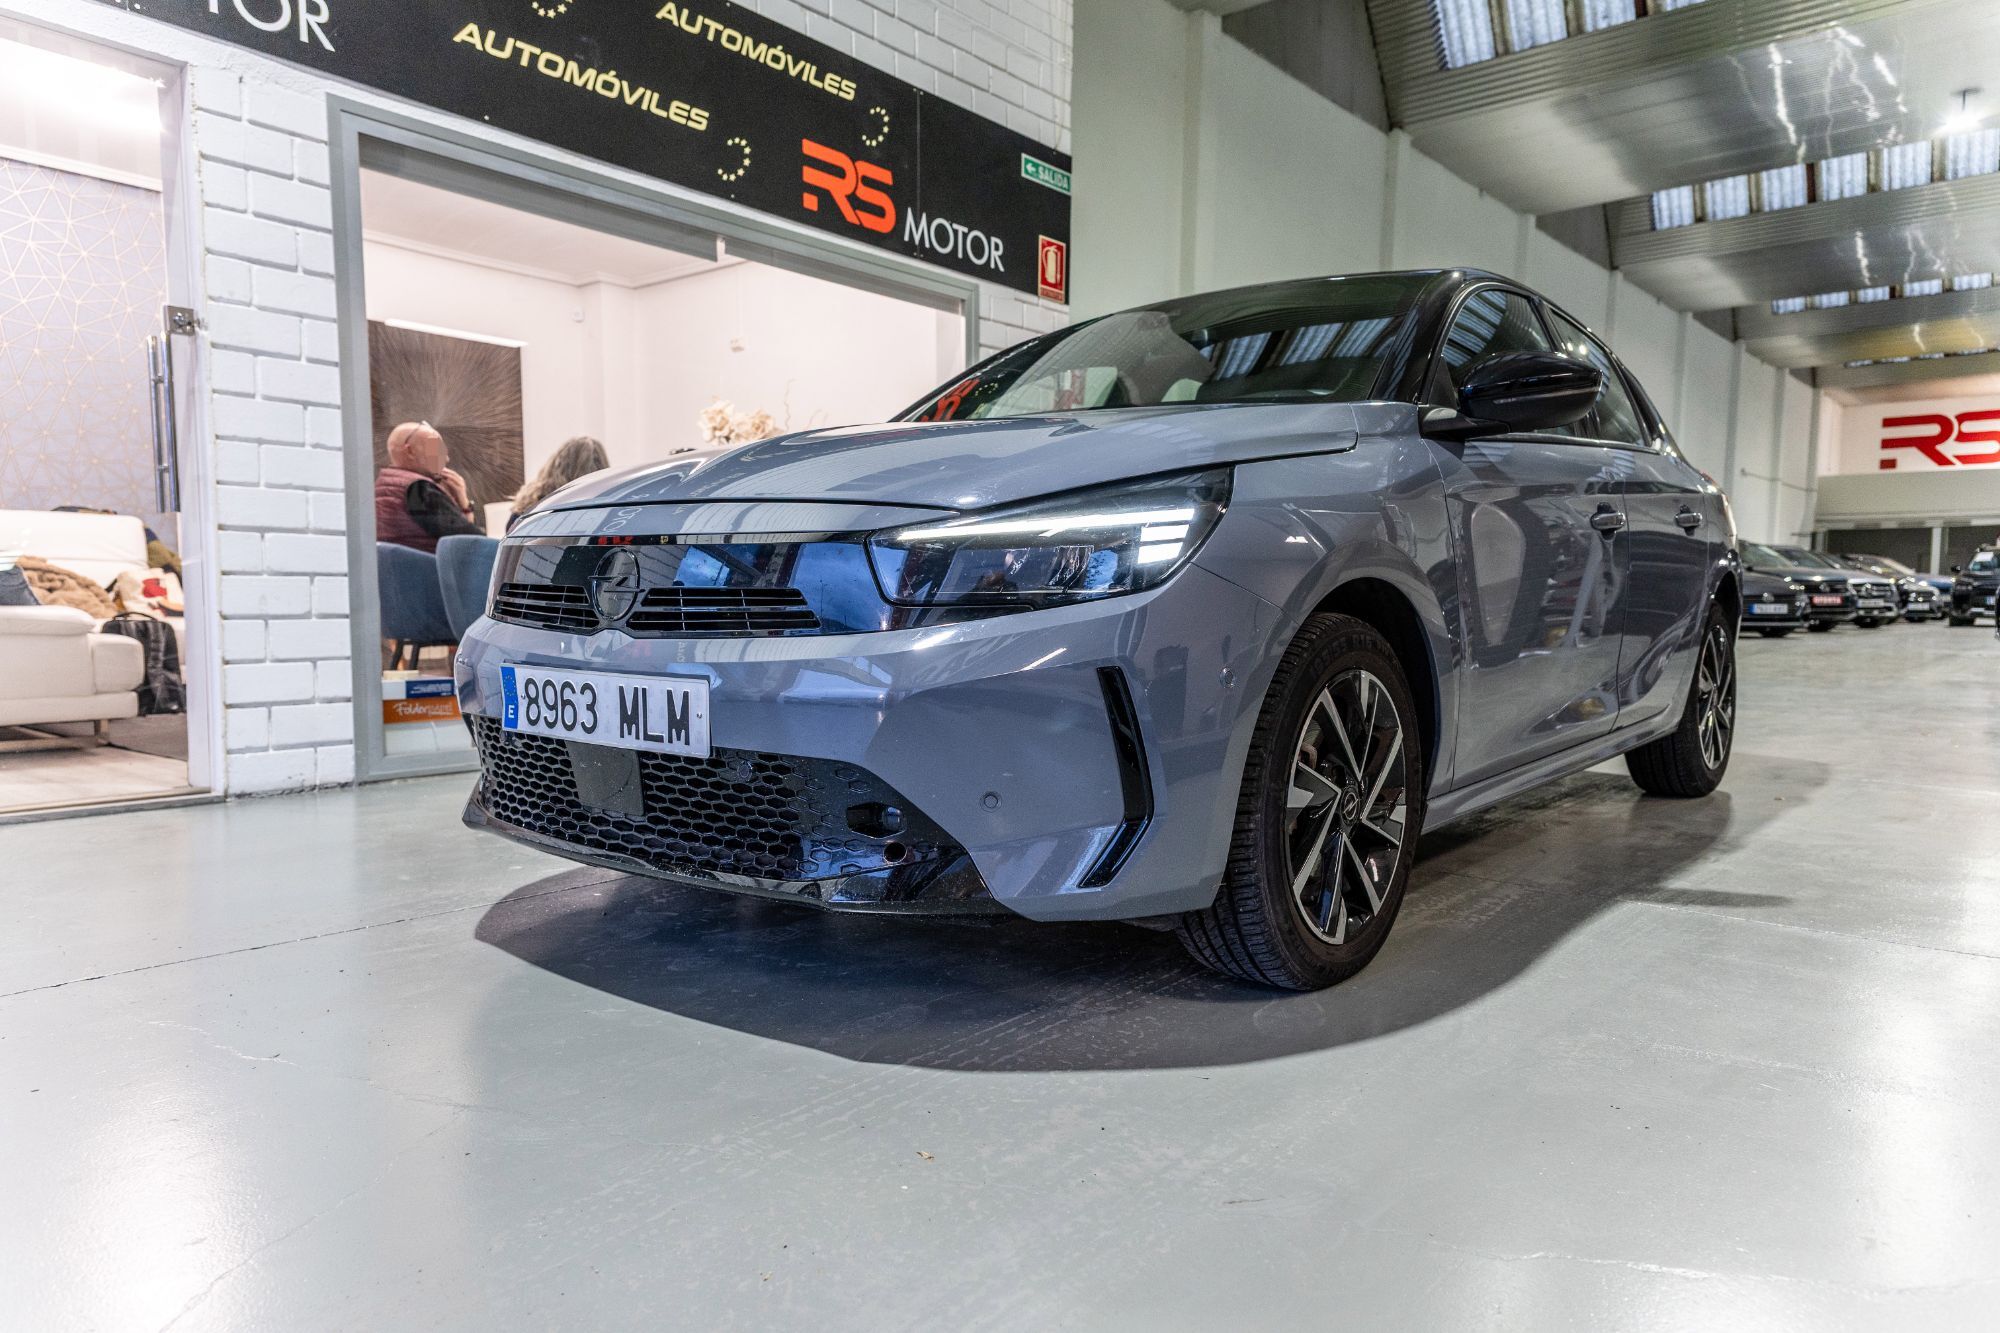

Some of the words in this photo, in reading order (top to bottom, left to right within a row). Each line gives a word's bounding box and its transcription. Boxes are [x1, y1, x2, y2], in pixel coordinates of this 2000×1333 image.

[453, 22, 710, 131] AUTOMÓVILES
[656, 1, 857, 101] AUTOMÓVILES
[801, 138, 897, 234] RS
[1038, 166, 1069, 189] SALIDA
[903, 207, 1004, 272] MOTOR
[1879, 409, 2000, 470] RS
[508, 705, 515, 719] E
[524, 677, 598, 735] 8963
[618, 684, 691, 746] MLM
